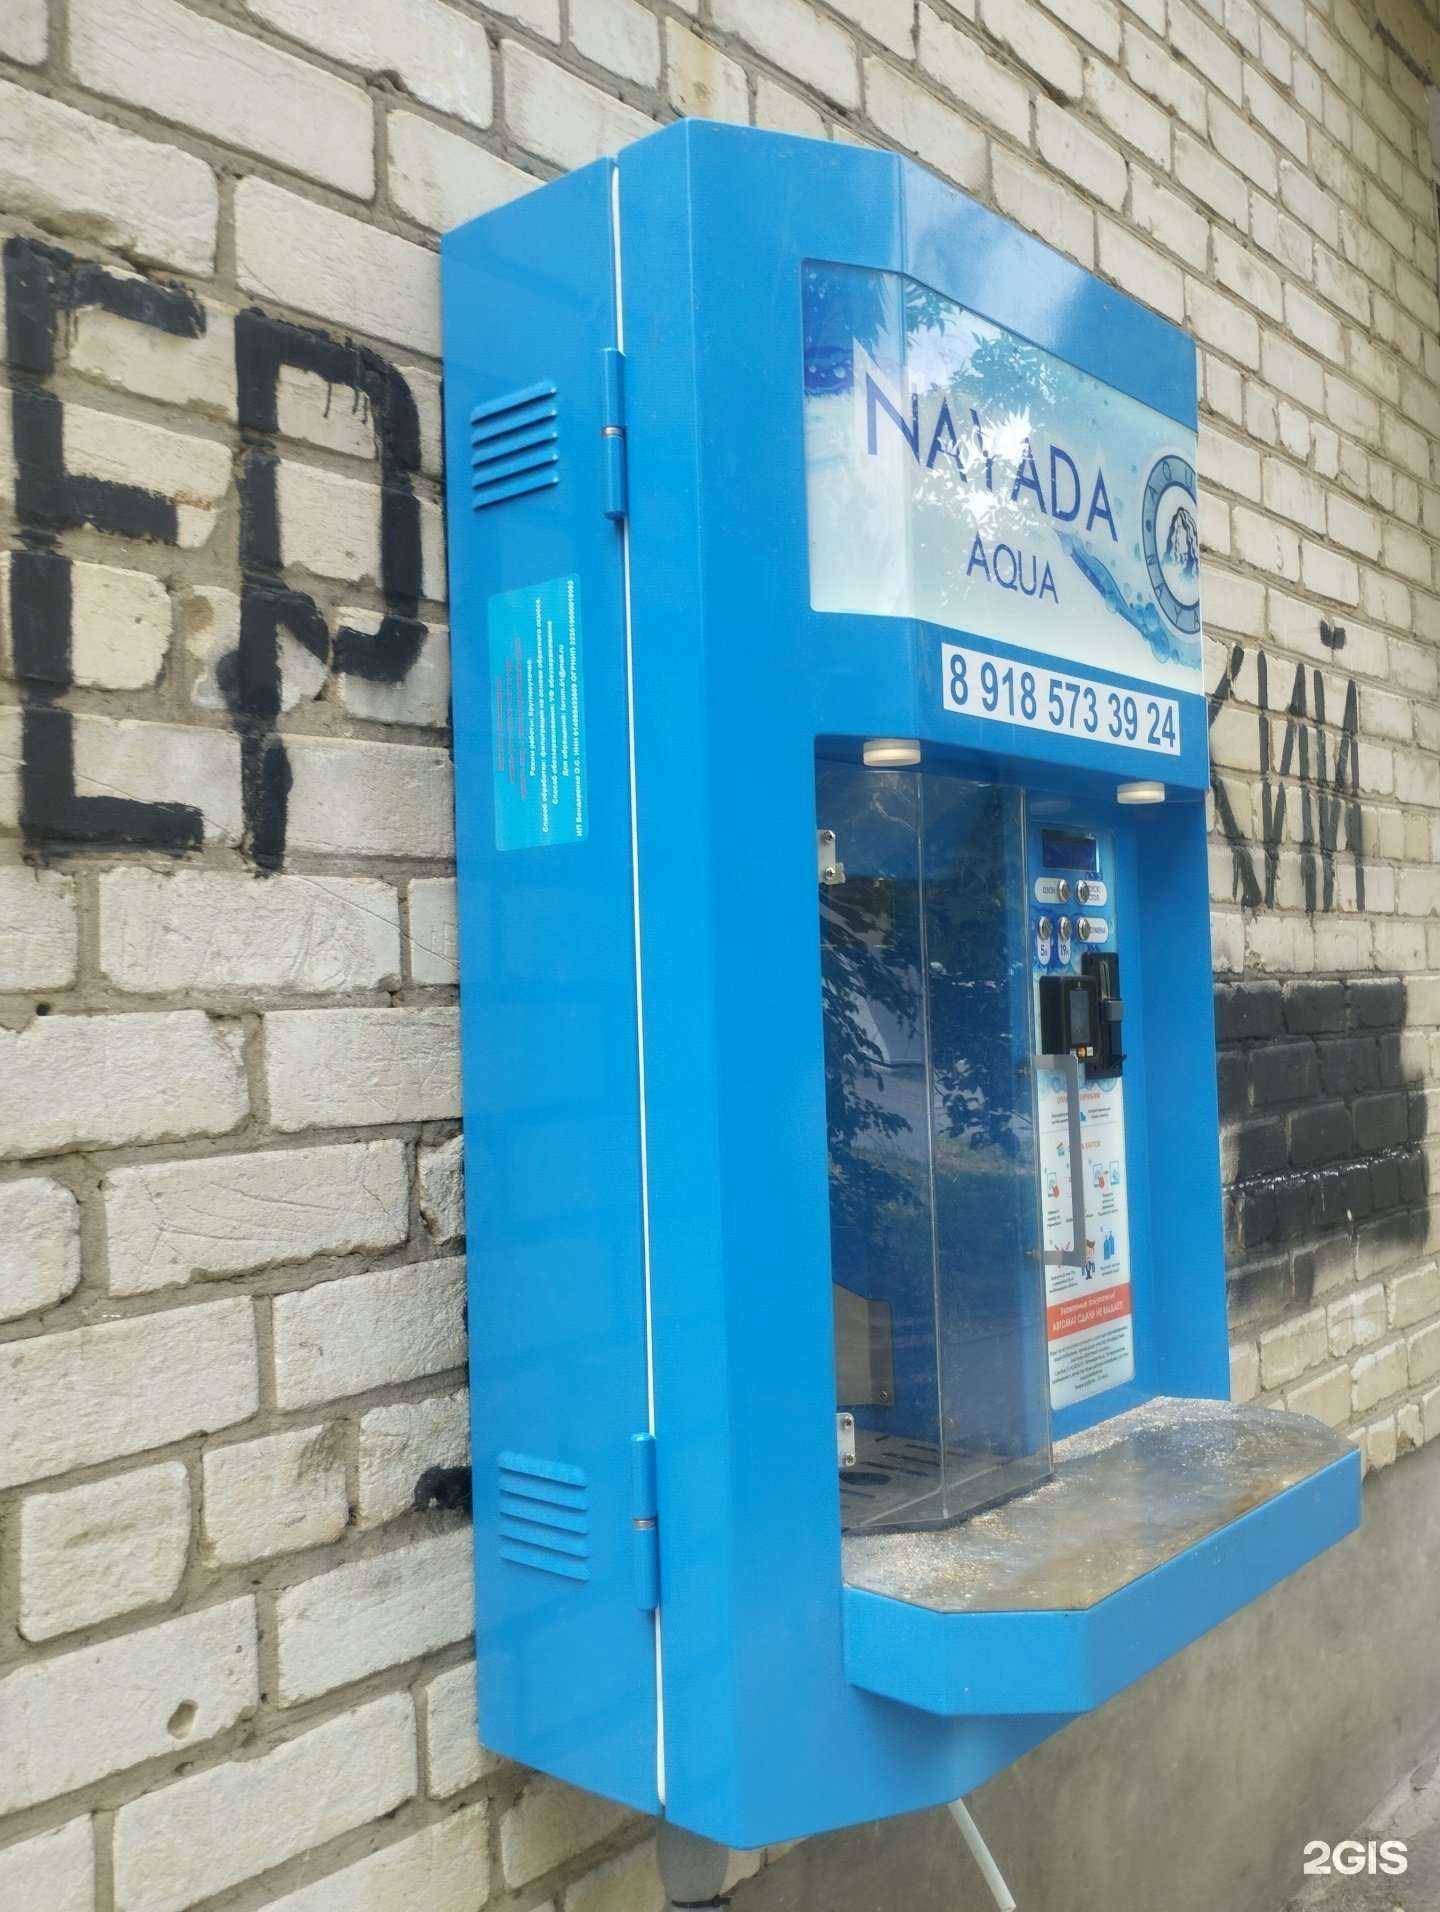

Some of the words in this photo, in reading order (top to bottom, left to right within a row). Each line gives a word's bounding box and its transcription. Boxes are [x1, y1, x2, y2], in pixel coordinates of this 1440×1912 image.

[866, 368, 1118, 543] NAYADA
[967, 533, 1060, 604] AQUA
[949, 653, 969, 707] 8
[981, 661, 1038, 722] 918
[1048, 676, 1099, 734] 573
[1108, 691, 1138, 742] 39
[1146, 700, 1177, 749] 24
